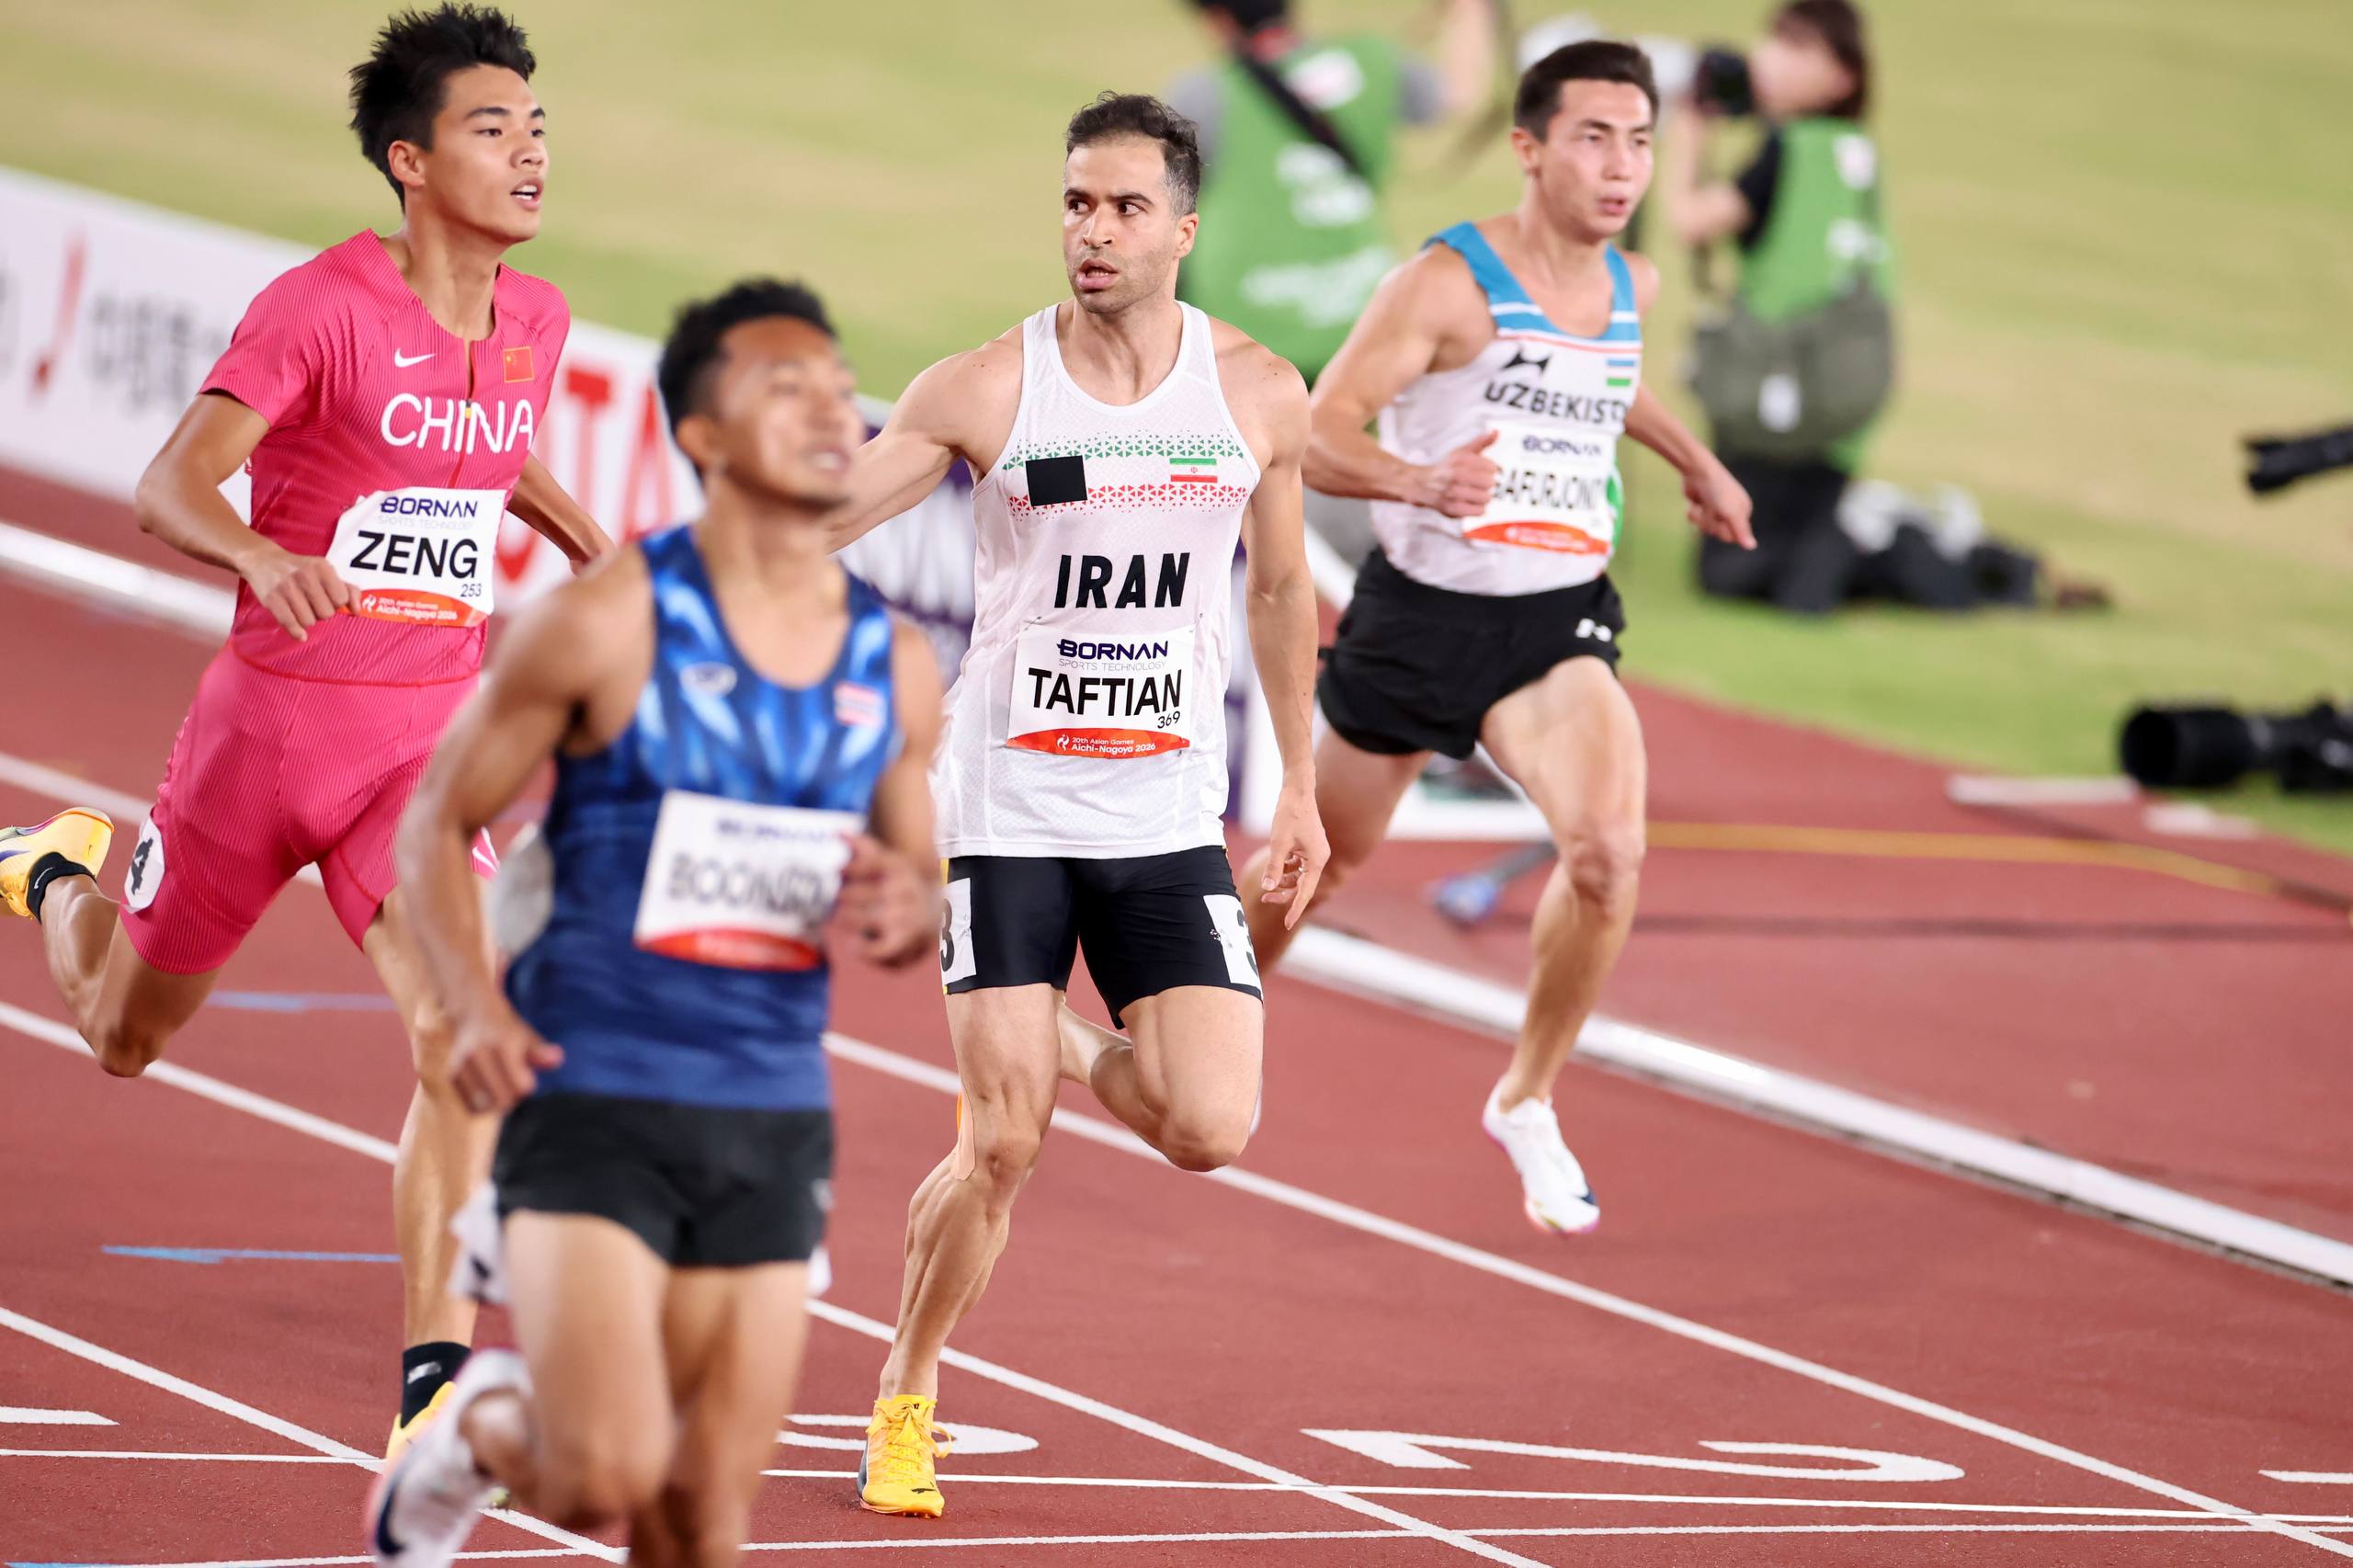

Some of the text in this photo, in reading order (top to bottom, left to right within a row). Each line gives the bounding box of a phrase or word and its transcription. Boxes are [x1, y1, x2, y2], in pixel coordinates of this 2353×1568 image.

[381, 393, 534, 454] CHINA
[381, 496, 478, 517] BORNAN
[349, 529, 479, 579] ZENG
[1054, 552, 1190, 608] IRAN
[460, 584, 482, 597] 253
[377, 605, 437, 620] Aichi-Nagoya
[1056, 639, 1168, 661] BORNAN
[1058, 658, 1167, 672] SPORTS TECHNOLOGY
[1028, 668, 1182, 717] TAFTIAN
[1156, 710, 1181, 729] 369
[1071, 742, 1156, 755] Aichi-Nagoya 2026
[1072, 736, 1088, 744] 20th
